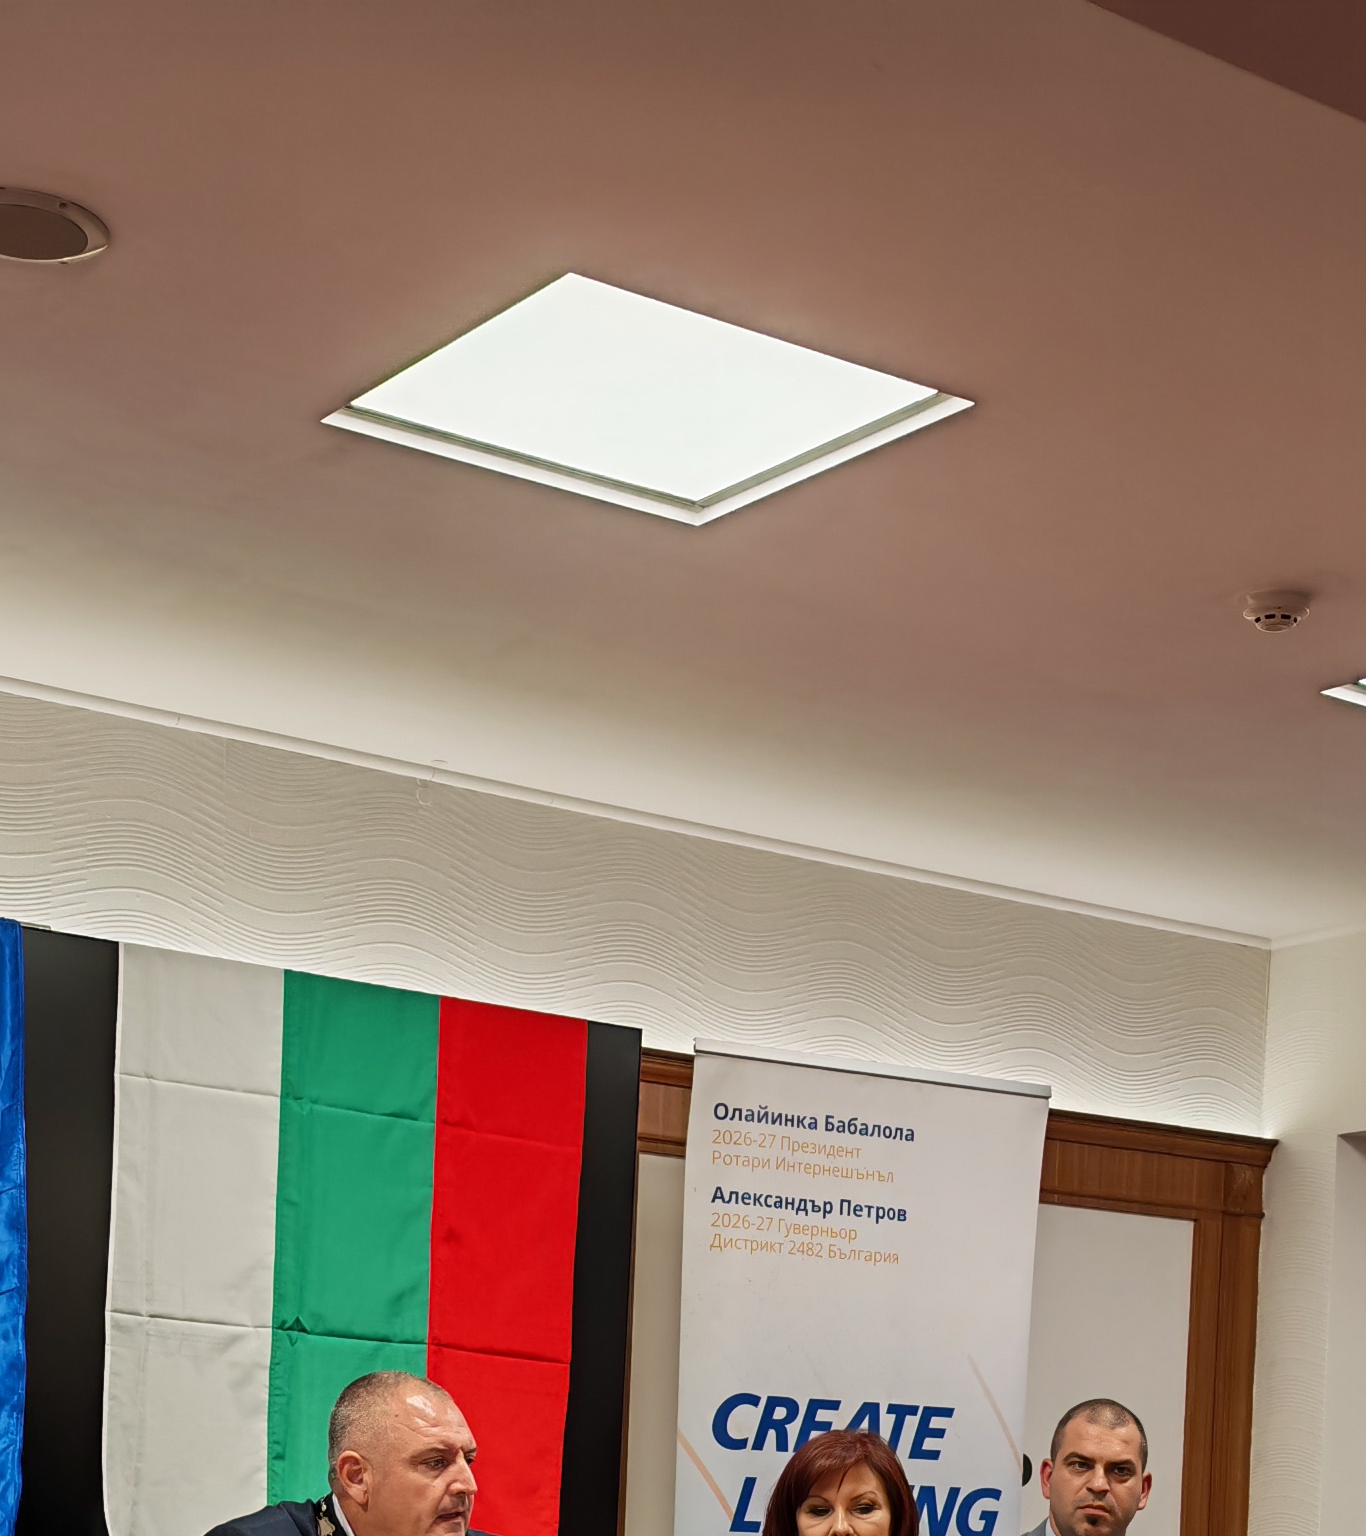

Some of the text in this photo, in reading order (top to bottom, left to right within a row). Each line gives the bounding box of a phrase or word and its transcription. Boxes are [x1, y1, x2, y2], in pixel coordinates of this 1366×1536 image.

[713, 1102, 916, 1143] Олайинка Бабалола
[711, 1129, 863, 1160] 2026-27 Президент
[711, 1150, 895, 1184] Ротари Интернешънъл
[710, 1185, 908, 1225] Александър Петров
[710, 1212, 858, 1245] 2026-27 Гуверньор
[709, 1233, 900, 1267] Дистрикт 2482 България
